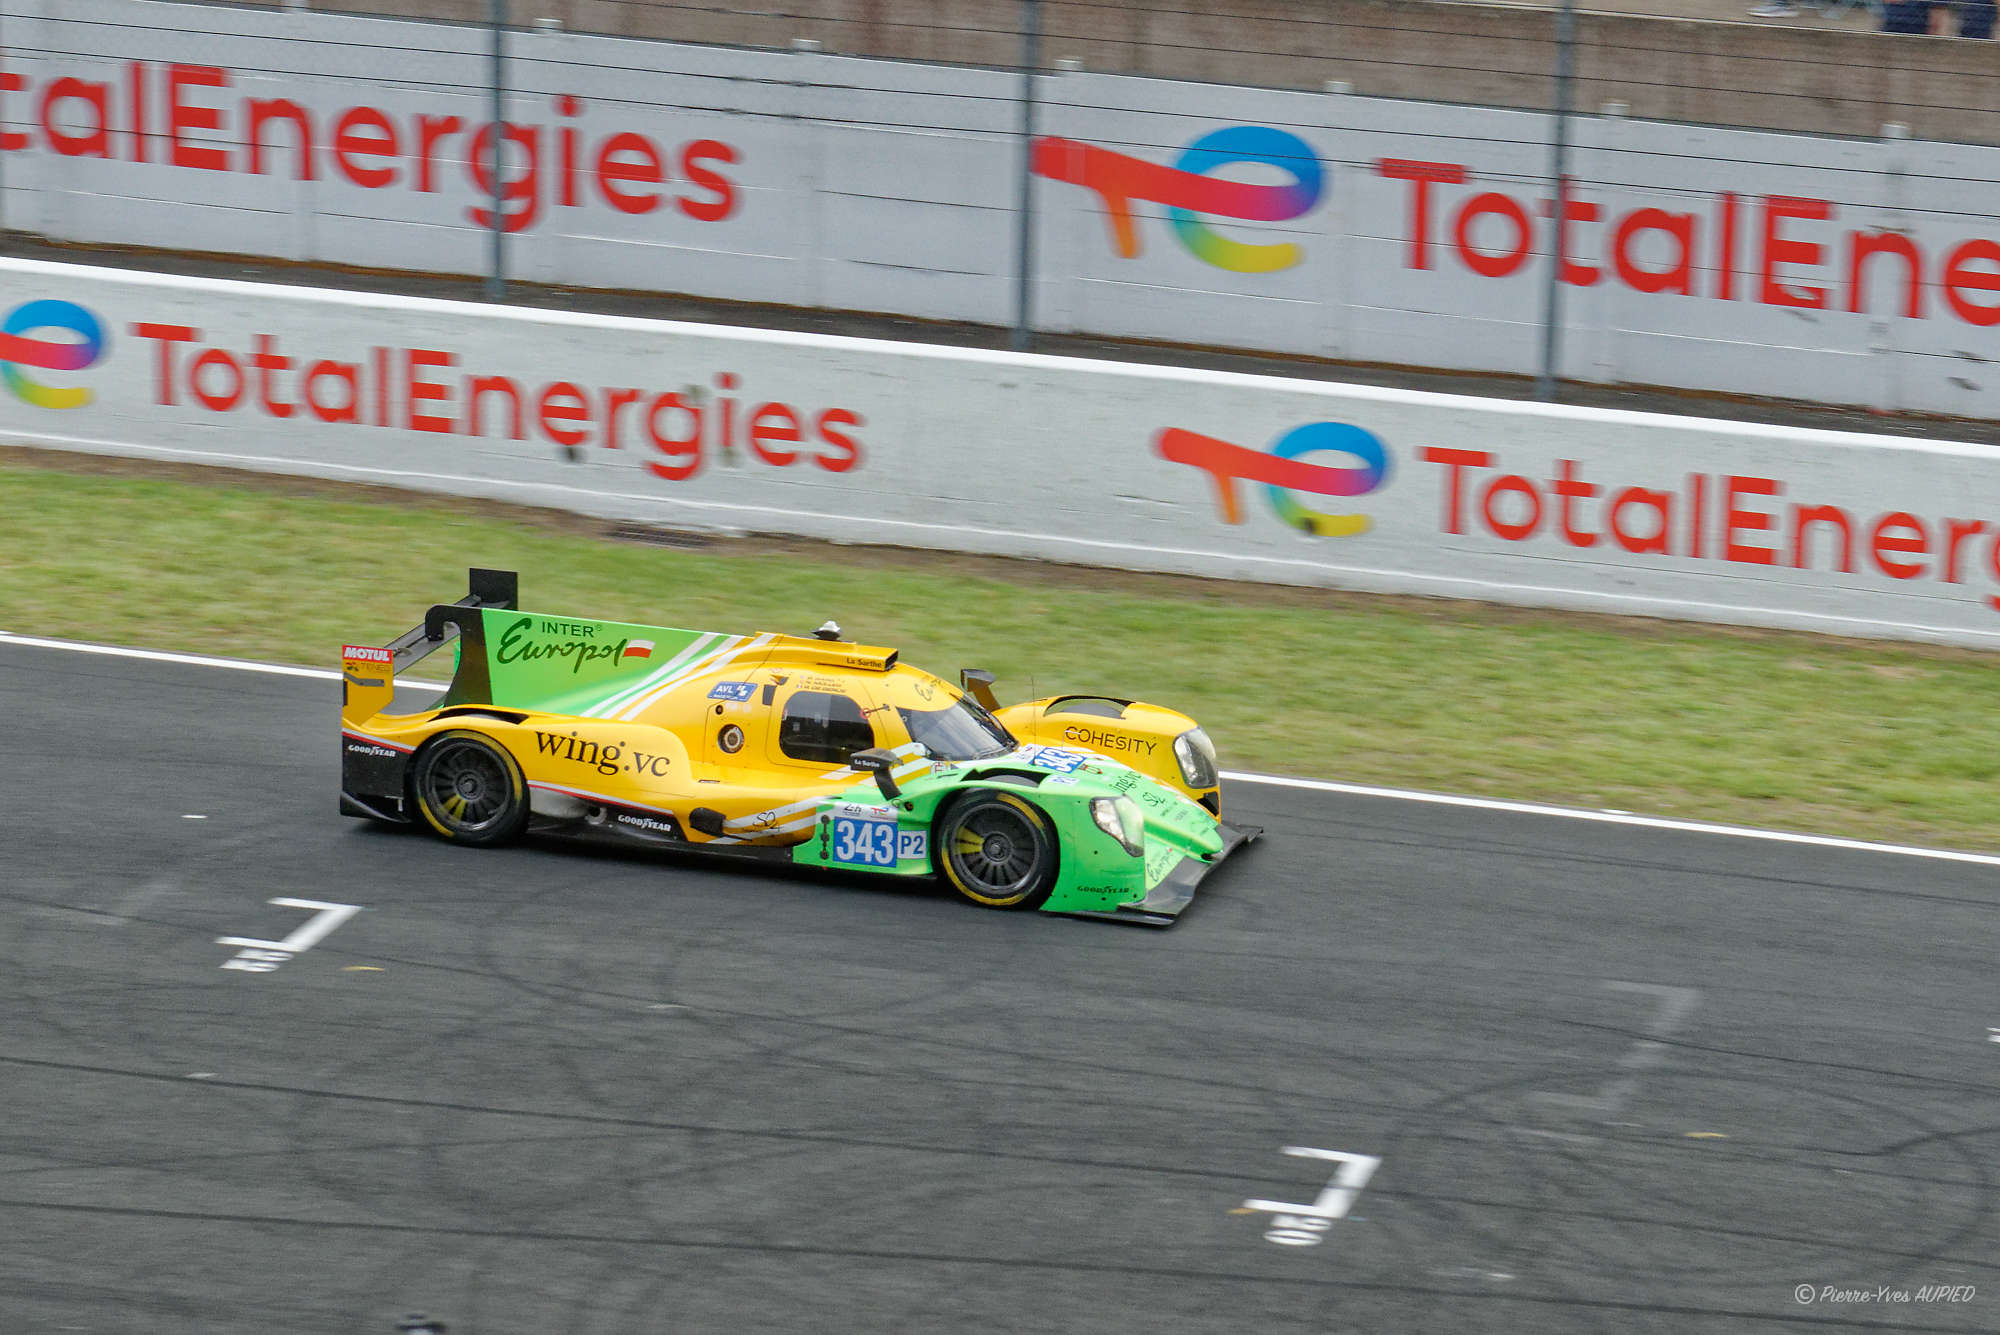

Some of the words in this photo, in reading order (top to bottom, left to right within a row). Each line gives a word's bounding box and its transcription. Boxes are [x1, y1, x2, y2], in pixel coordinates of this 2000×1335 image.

[130, 322, 866, 482] TotalEnergies
[1418, 445, 2000, 612] TotalEner
[344, 647, 390, 661] MOTUL
[497, 618, 627, 673] Europol
[716, 685, 733, 694] AVL
[348, 744, 396, 757] GOODYEAR
[1065, 726, 1157, 755] COHESITY
[618, 814, 672, 832] GOODYEAR
[836, 820, 894, 865] 343
[900, 835, 923, 855] P2
